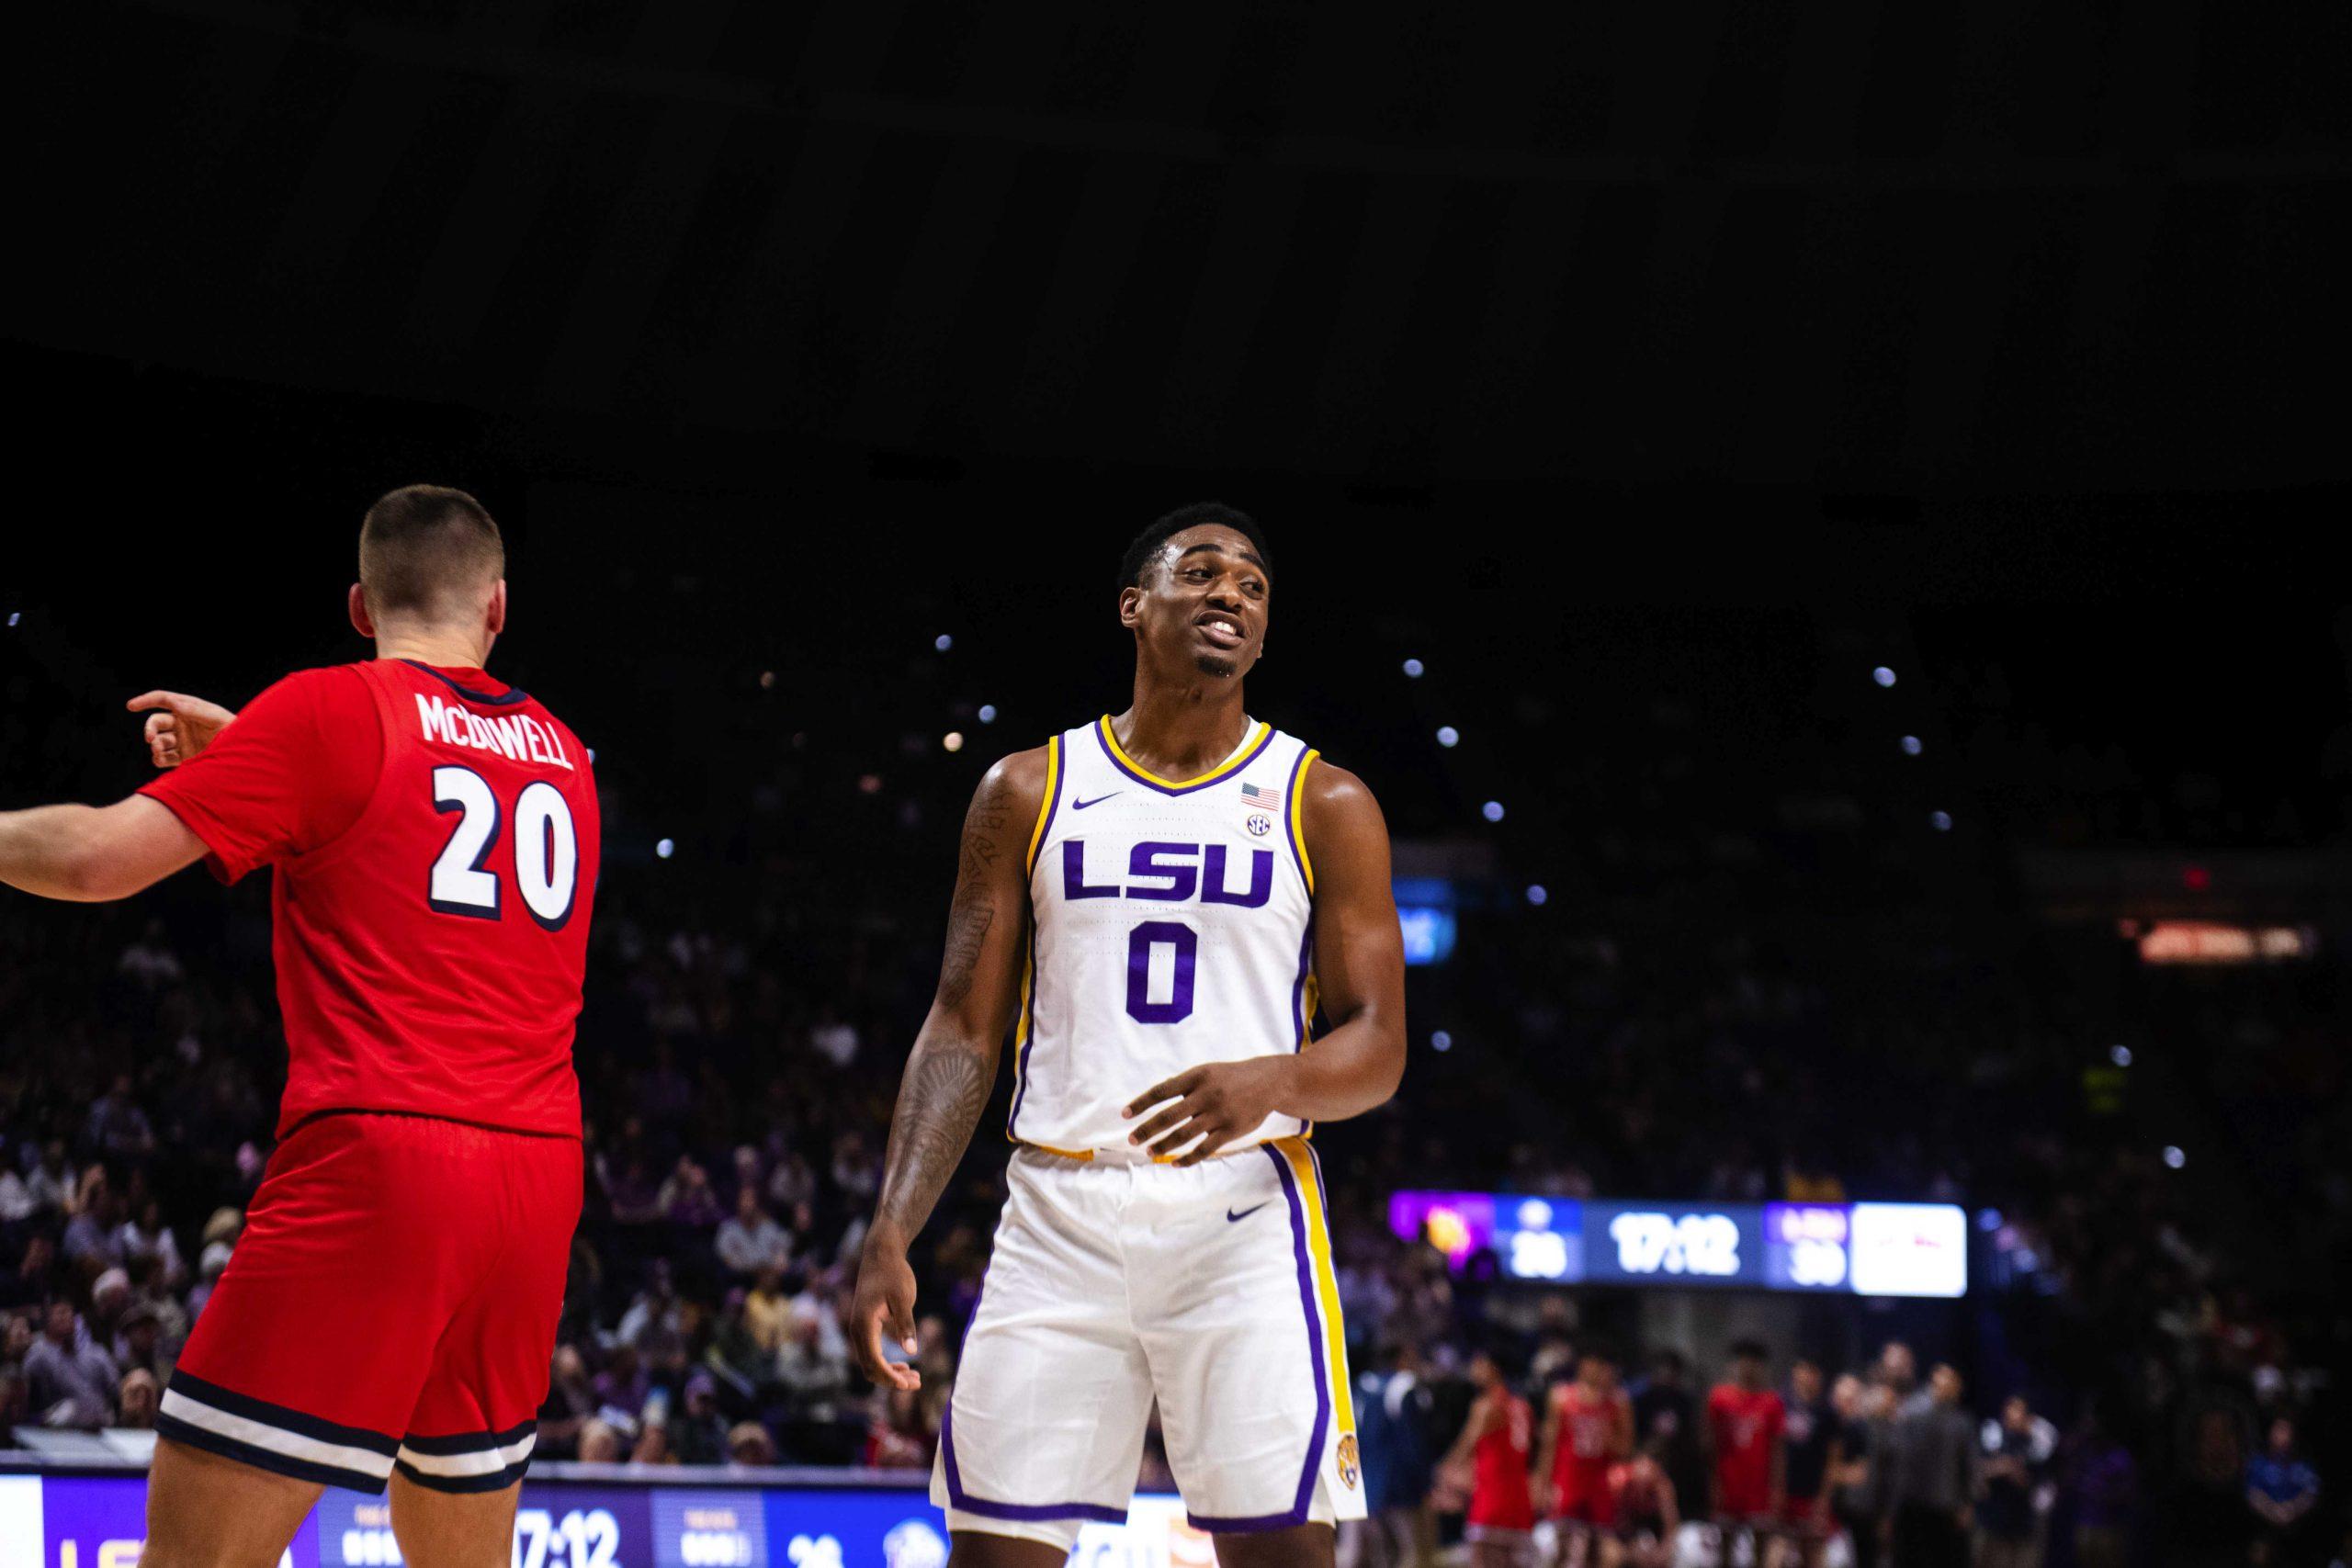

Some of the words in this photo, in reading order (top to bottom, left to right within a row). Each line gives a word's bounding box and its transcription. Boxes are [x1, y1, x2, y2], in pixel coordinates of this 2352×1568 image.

[429, 764, 579, 931] 20
[1247, 814, 1271, 836] SEC
[1063, 840, 1273, 908] LSU
[1126, 920, 1197, 1023] 0
[1610, 1212, 1740, 1276] 17:12
